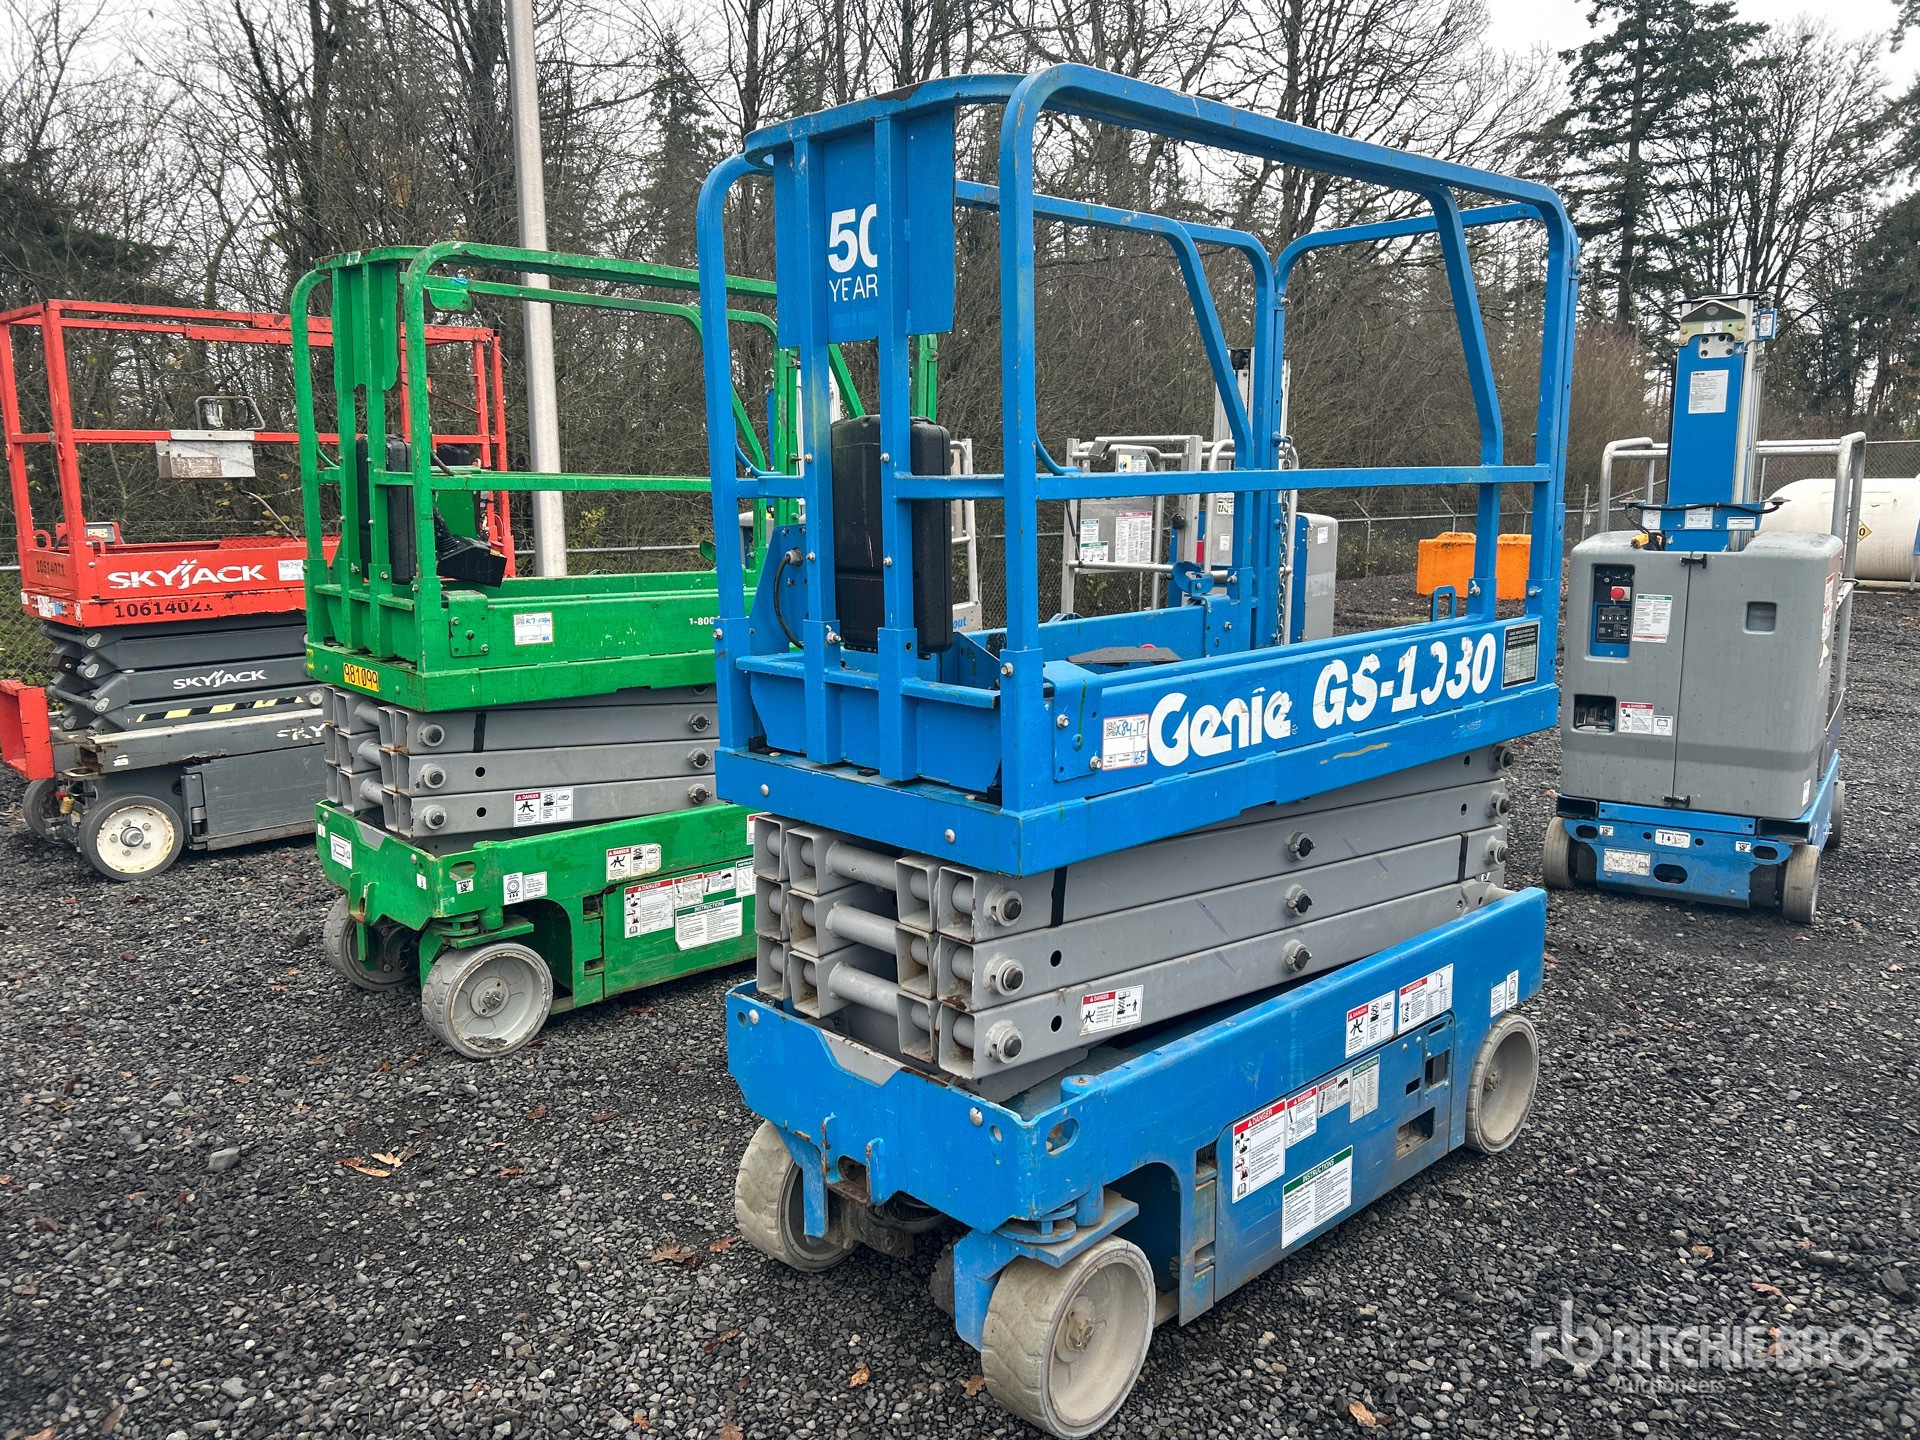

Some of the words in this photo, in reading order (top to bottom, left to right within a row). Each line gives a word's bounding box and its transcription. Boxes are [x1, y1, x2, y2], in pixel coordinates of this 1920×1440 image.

[106, 558, 268, 590] SKYJACK
[173, 669, 267, 690] SKYJACK
[344, 663, 378, 689] 981099
[1149, 686, 1293, 767] Genie
[1093, 993, 1109, 1002] DANGER
[1297, 1090, 1313, 1104] DANGER
[1252, 1108, 1273, 1126] DANGER
[1302, 1158, 1335, 1183] INSTRUCTIONS
